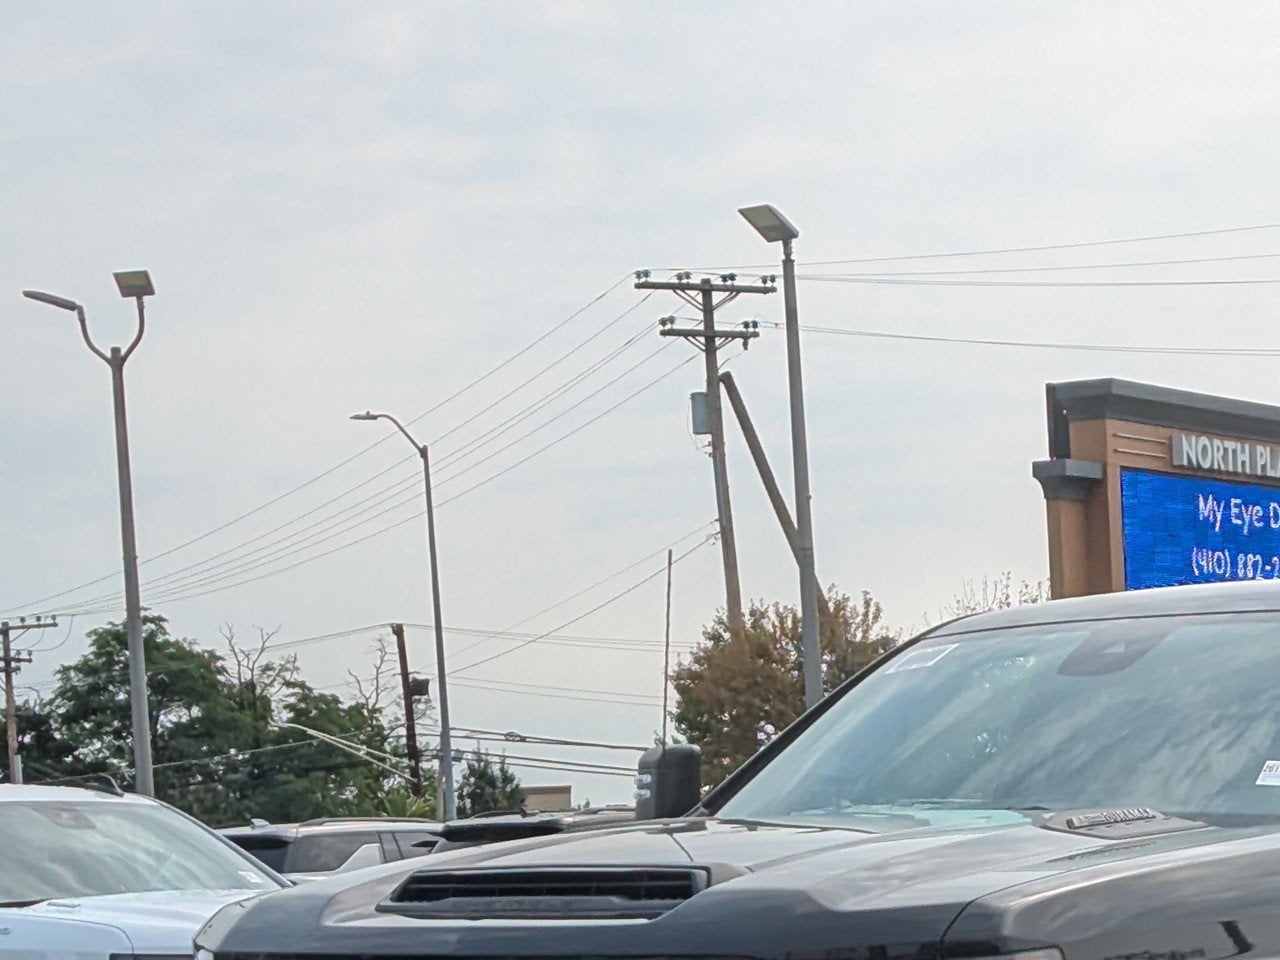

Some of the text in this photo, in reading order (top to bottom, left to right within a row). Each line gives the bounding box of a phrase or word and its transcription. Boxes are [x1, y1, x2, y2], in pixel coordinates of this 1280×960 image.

[1179, 432, 1251, 475] NORTH
[1198, 492, 1226, 533] My
[1230, 497, 1265, 536] Eye
[1191, 546, 1231, 578] (410)
